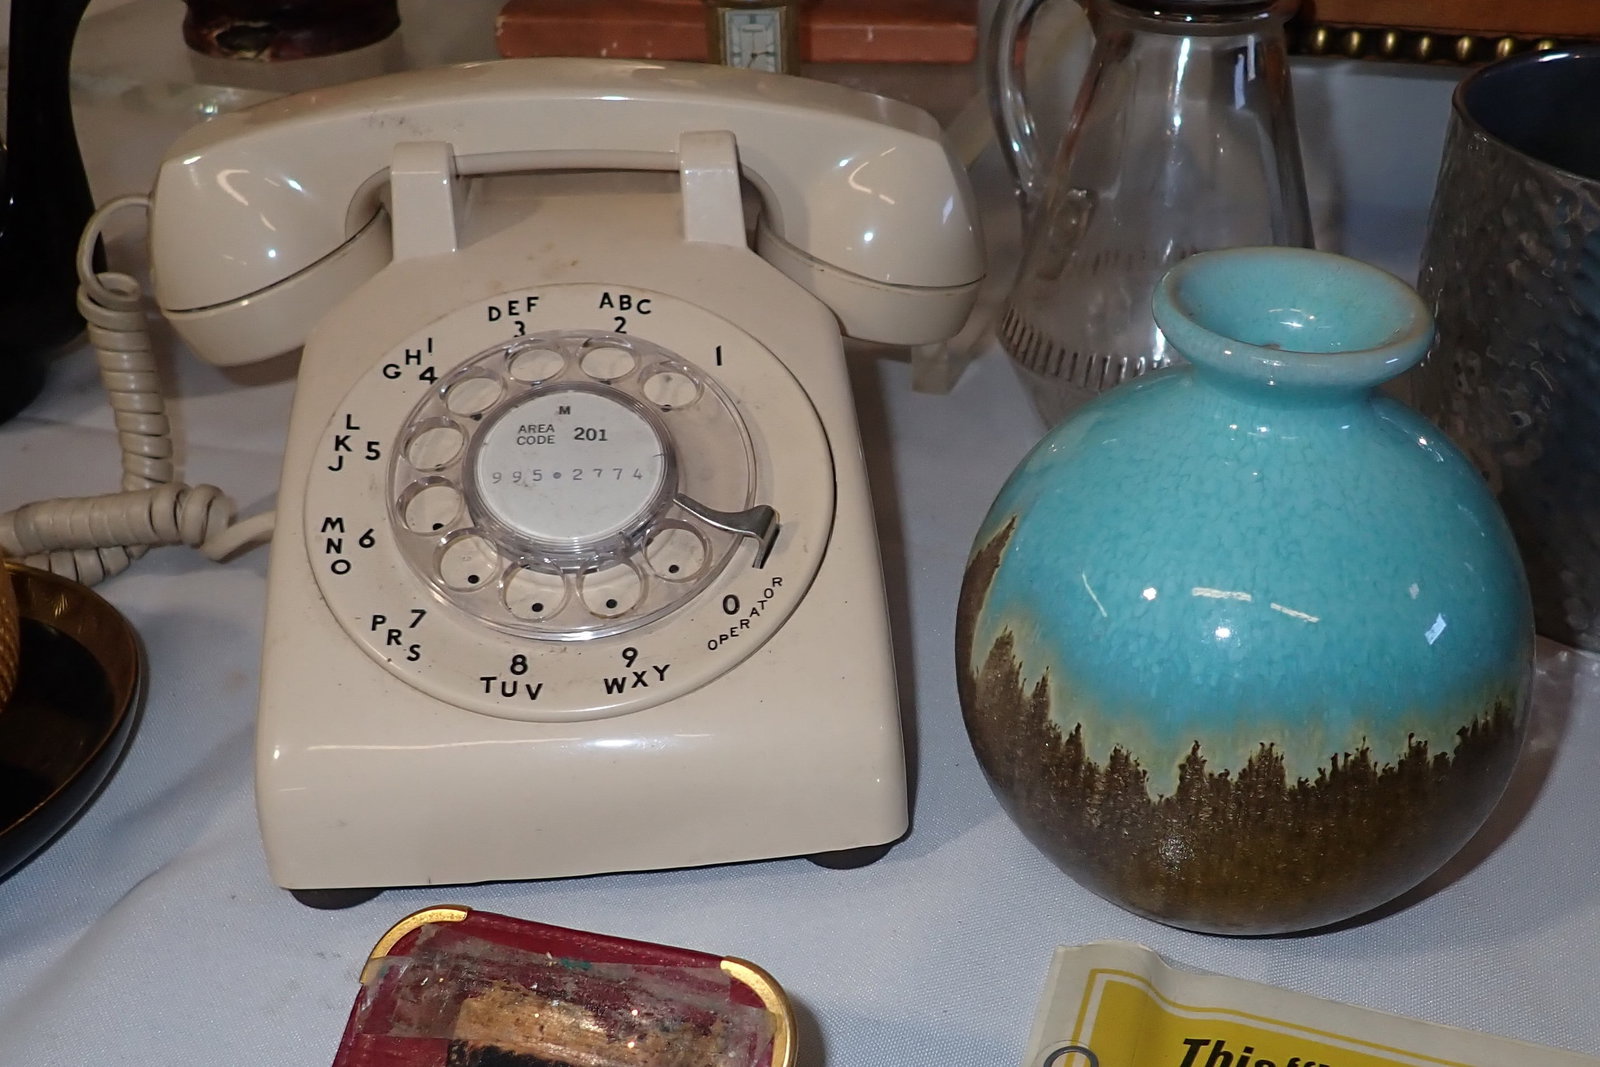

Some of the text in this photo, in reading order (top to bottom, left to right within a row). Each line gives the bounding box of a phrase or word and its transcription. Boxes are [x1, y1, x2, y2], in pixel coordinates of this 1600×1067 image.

[488, 296, 539, 322] DEF
[599, 292, 651, 314] ABC
[513, 320, 526, 338] 3
[614, 316, 627, 334] 2
[715, 345, 722, 366] 1
[419, 366, 438, 385] 4
[558, 405, 571, 415] M
[517, 423, 555, 434] AREA
[573, 427, 608, 442] 201
[516, 434, 556, 446] CODE
[365, 441, 381, 461] 5
[358, 528, 375, 548] 6
[409, 609, 427, 628] 7
[707, 576, 783, 651] OPERATOR
[510, 654, 528, 675] 8
[621, 646, 638, 668] 9
[479, 676, 543, 701] TUV
[604, 664, 671, 695] WXY
